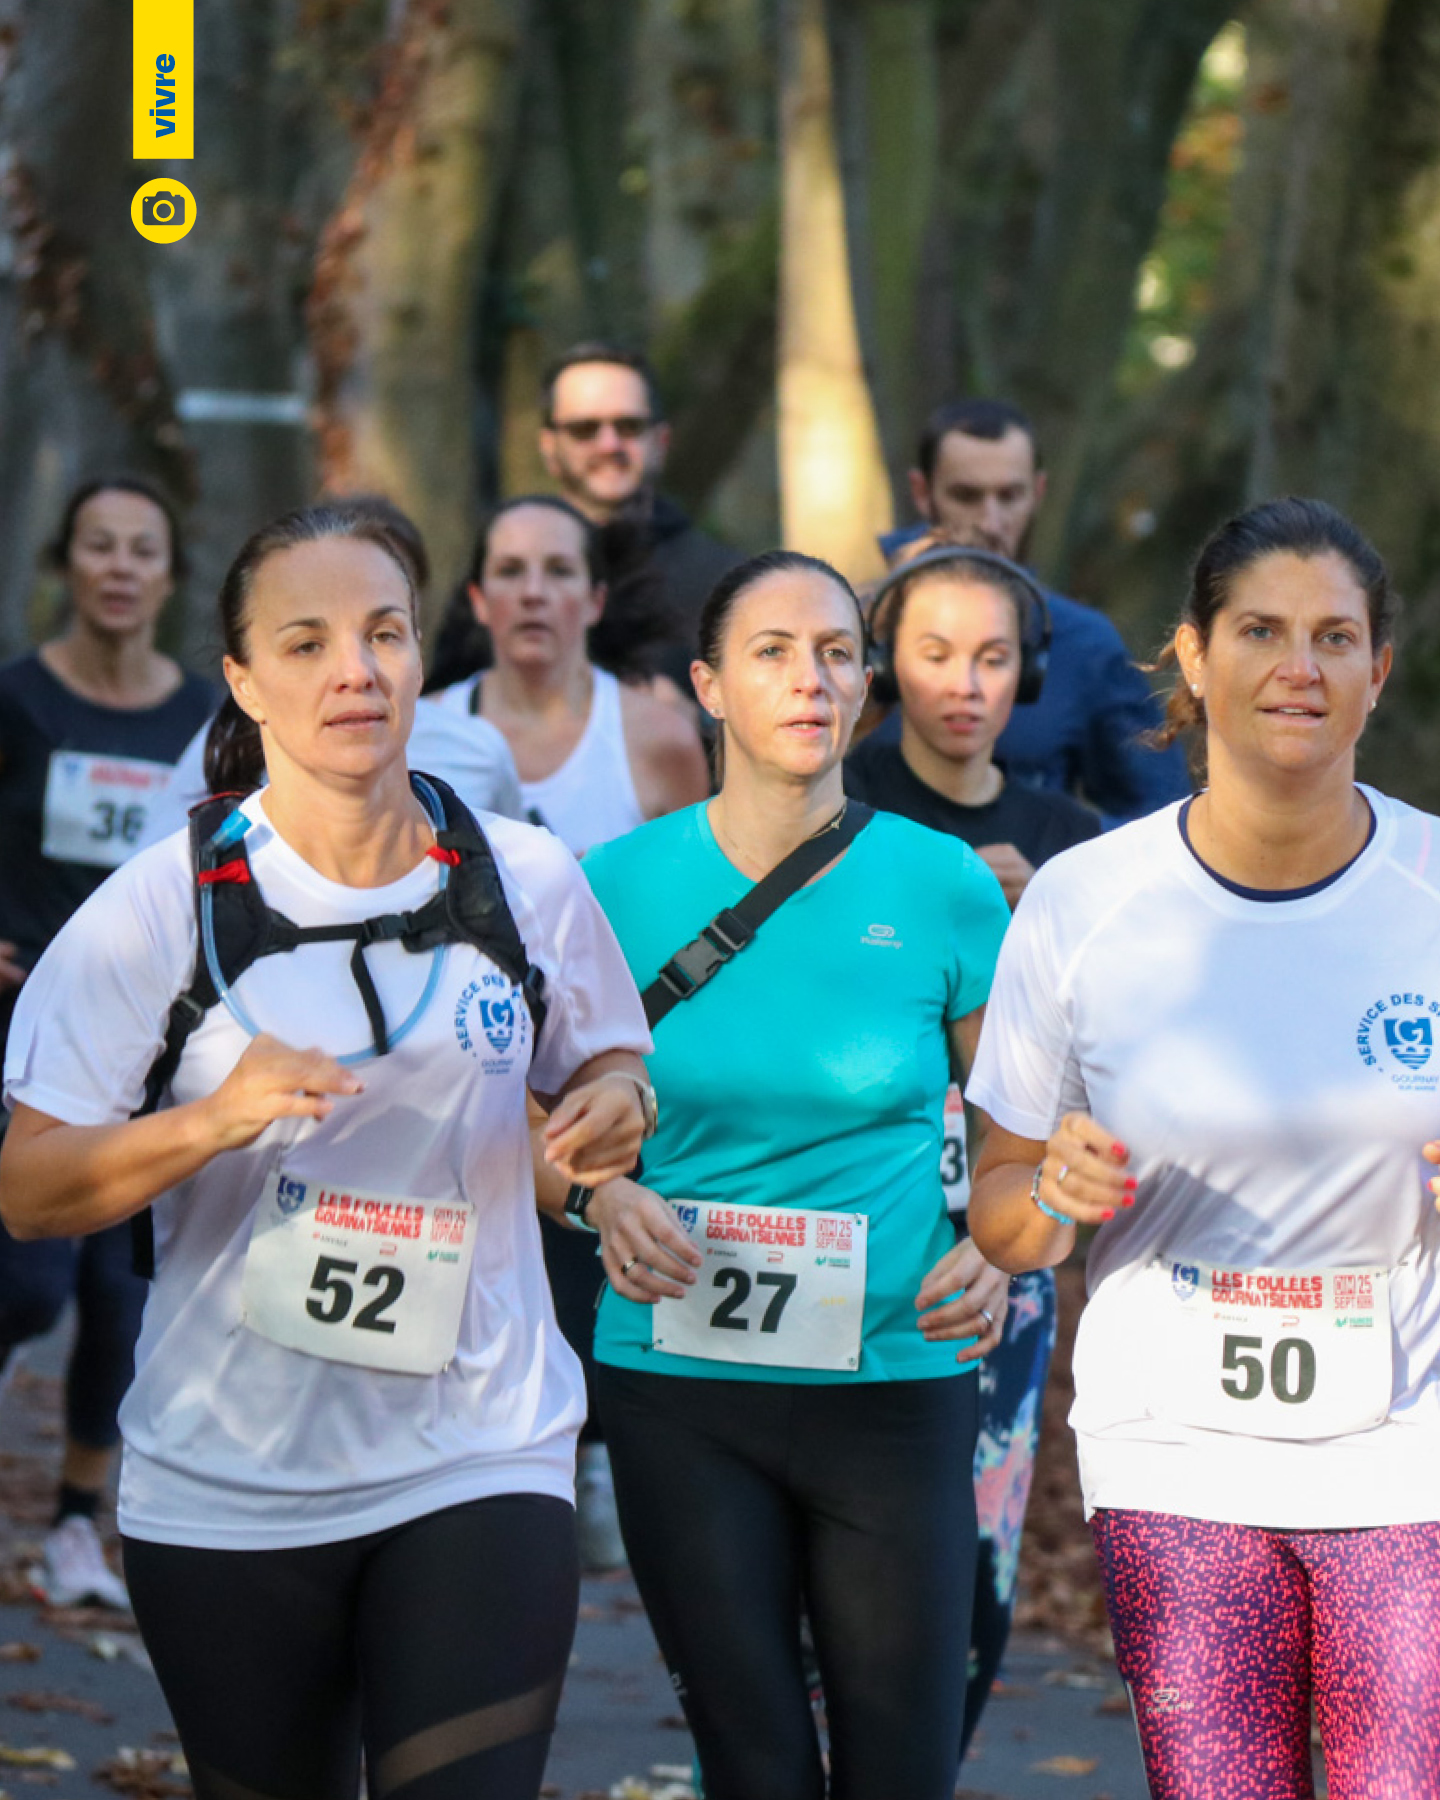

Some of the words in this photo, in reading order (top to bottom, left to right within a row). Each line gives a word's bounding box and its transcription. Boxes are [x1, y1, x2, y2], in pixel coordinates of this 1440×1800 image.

[455, 980, 481, 1051] SERVICE
[1356, 999, 1388, 1066] SERVICE
[1390, 993, 1424, 1006] DES
[318, 1190, 353, 1210] LES
[707, 1209, 735, 1225] LES
[737, 1212, 807, 1231] FOULÉES
[839, 1220, 853, 1237] 25
[1212, 1269, 1243, 1288] LES
[1246, 1273, 1323, 1292] FOULÉES
[1358, 1275, 1373, 1294] 25
[305, 1254, 406, 1334] 52
[710, 1267, 798, 1333] 27
[1334, 1296, 1356, 1309] SEPT
[1220, 1334, 1316, 1403] 50
